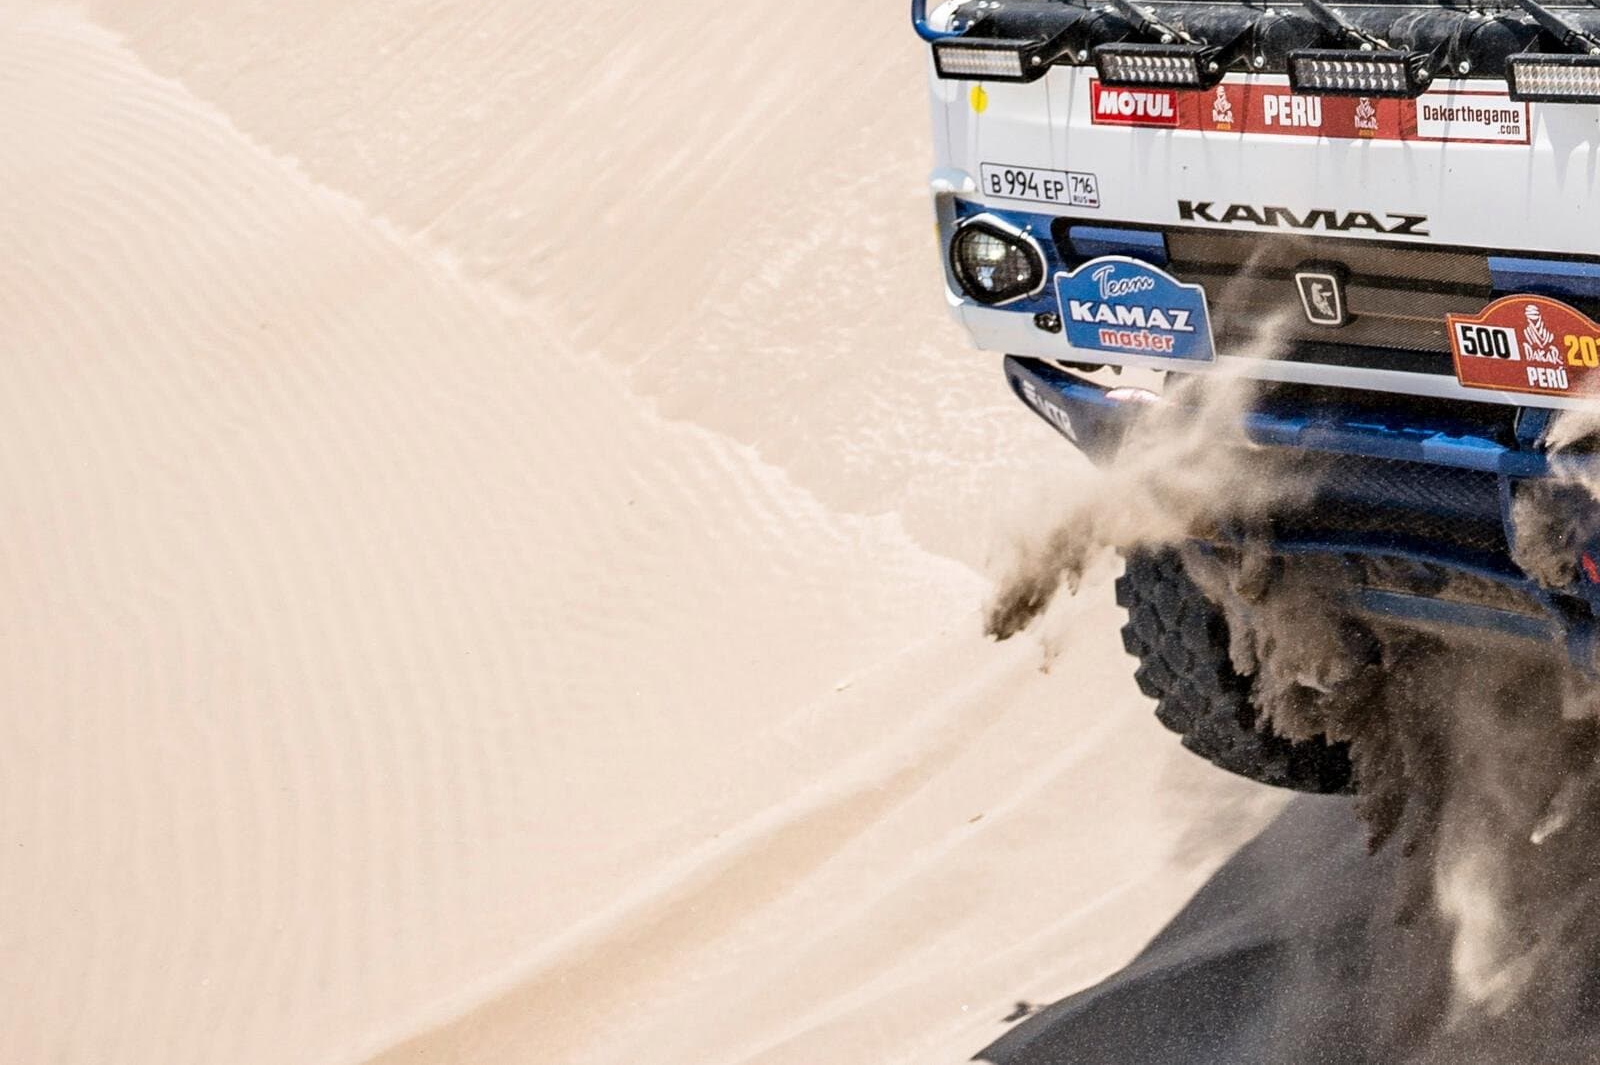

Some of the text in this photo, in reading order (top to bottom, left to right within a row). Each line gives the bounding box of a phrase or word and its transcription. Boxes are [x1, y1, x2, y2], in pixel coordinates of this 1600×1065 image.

[1098, 91, 1174, 117] MOTUL
[1423, 104, 1520, 127] Dakarthegame
[1497, 124, 1521, 135] .com
[1177, 200, 1431, 236] KAMAZ
[1092, 264, 1155, 300] Team
[1068, 299, 1195, 332] KAMAZ
[1099, 328, 1175, 353] master
[1460, 325, 1512, 360] 500
[1526, 366, 1569, 390] PERÚ
